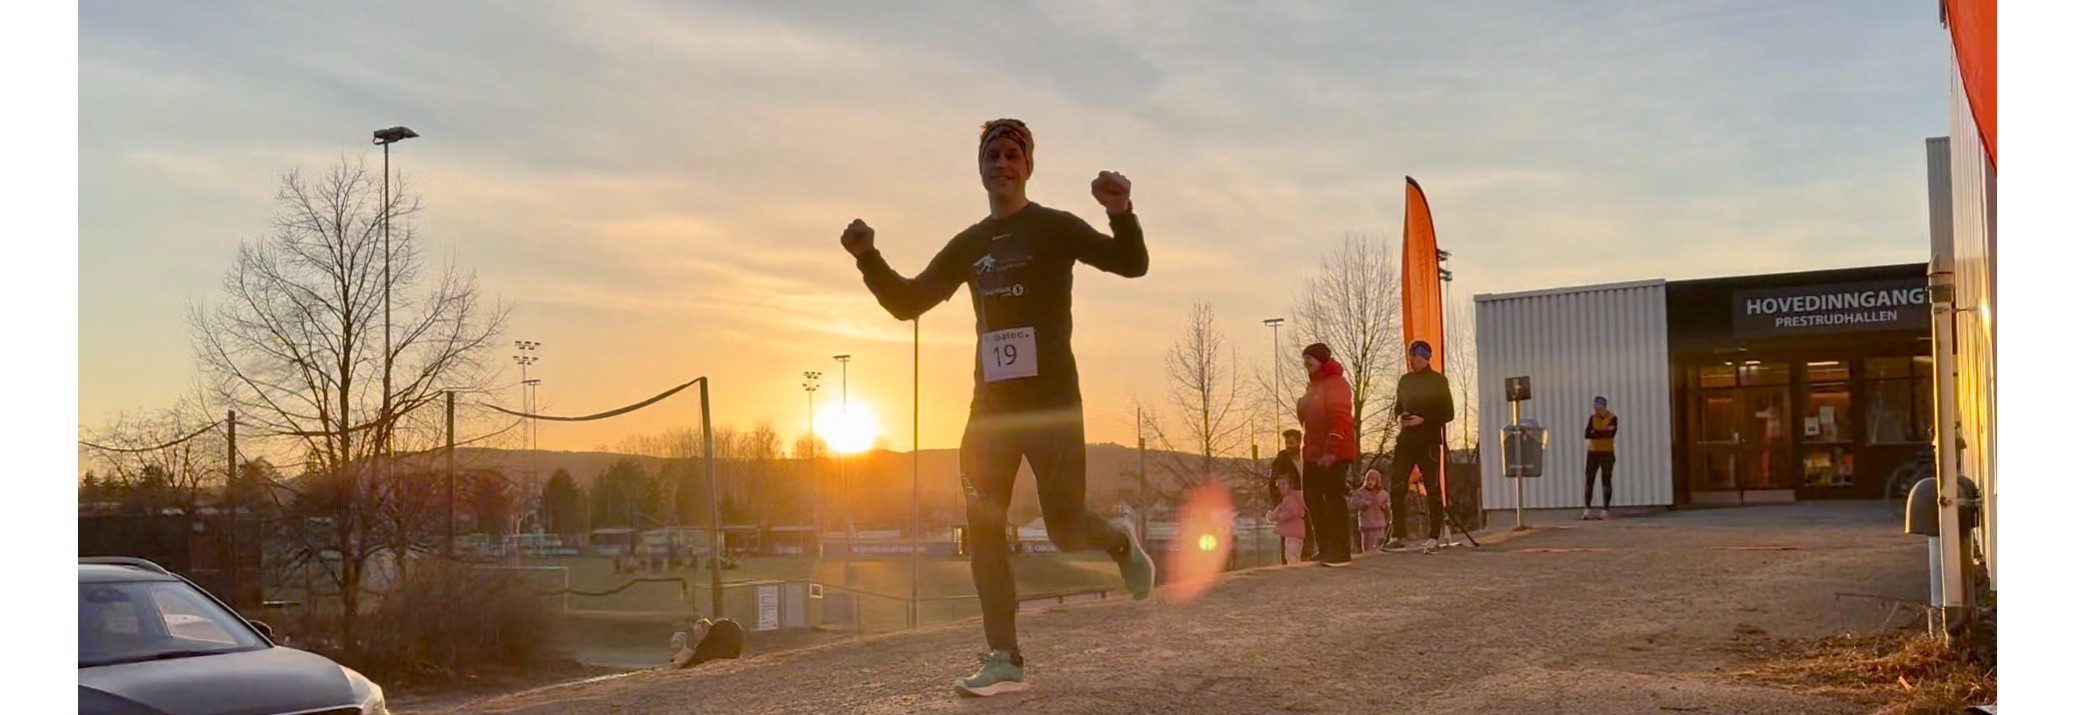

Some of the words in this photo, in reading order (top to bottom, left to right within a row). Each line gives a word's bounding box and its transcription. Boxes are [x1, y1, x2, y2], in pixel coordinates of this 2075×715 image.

[1747, 287, 1925, 315] HOVEDINNGANG
[1775, 310, 1898, 328] PRESTRUDHALLEN
[993, 344, 1017, 368] 19
